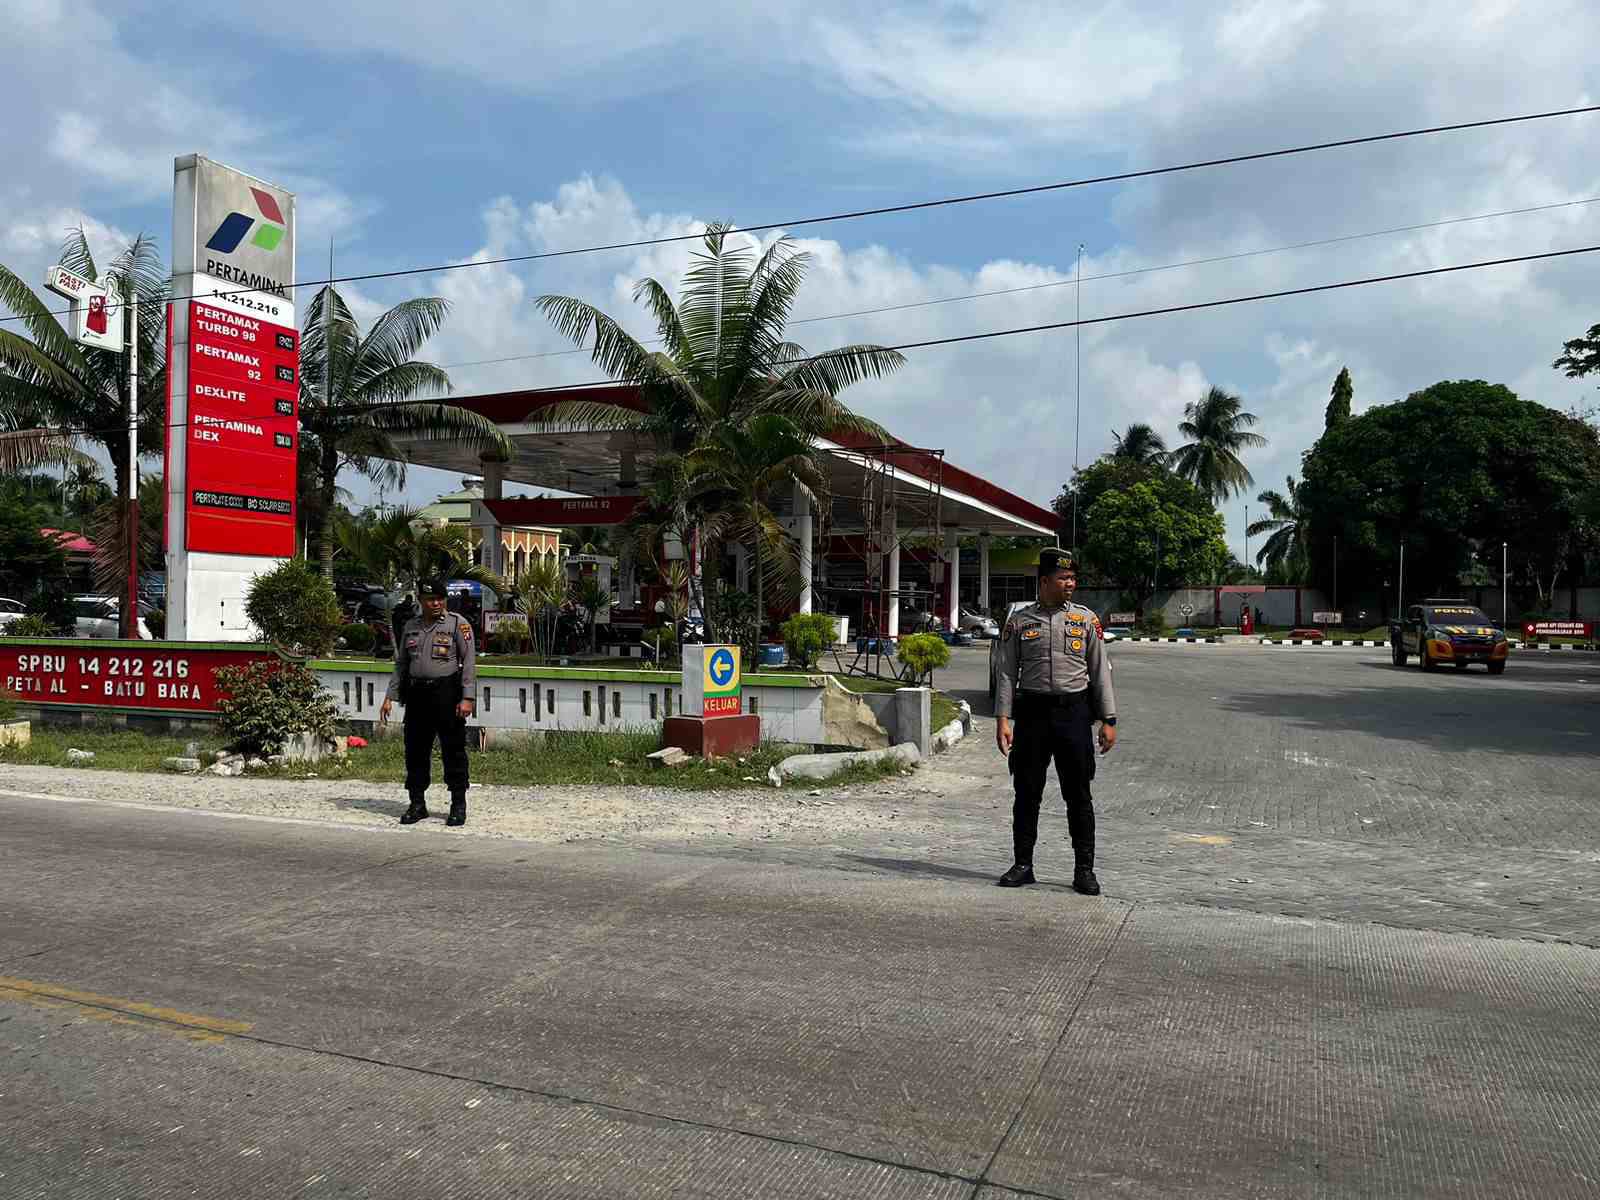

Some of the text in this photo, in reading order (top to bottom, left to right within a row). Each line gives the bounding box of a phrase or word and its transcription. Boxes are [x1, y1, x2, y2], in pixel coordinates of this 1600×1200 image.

[207, 259, 285, 297] PERTAMINA
[212, 289, 279, 316] 14.212.216
[196, 306, 260, 331] PERTAMAX
[196, 320, 256, 342] TURBO 98
[195, 343, 260, 367] PERTAMAX
[247, 369, 261, 381] 92
[195, 384, 246, 402] DEXLITE
[194, 415, 263, 436] PERTAMINA
[194, 429, 219, 442] DEX
[18, 655, 189, 678] SPBU 14 212 216
[104, 680, 145, 697] BATU
[158, 683, 201, 700] BARA
[704, 698, 737, 712] KELUAR
